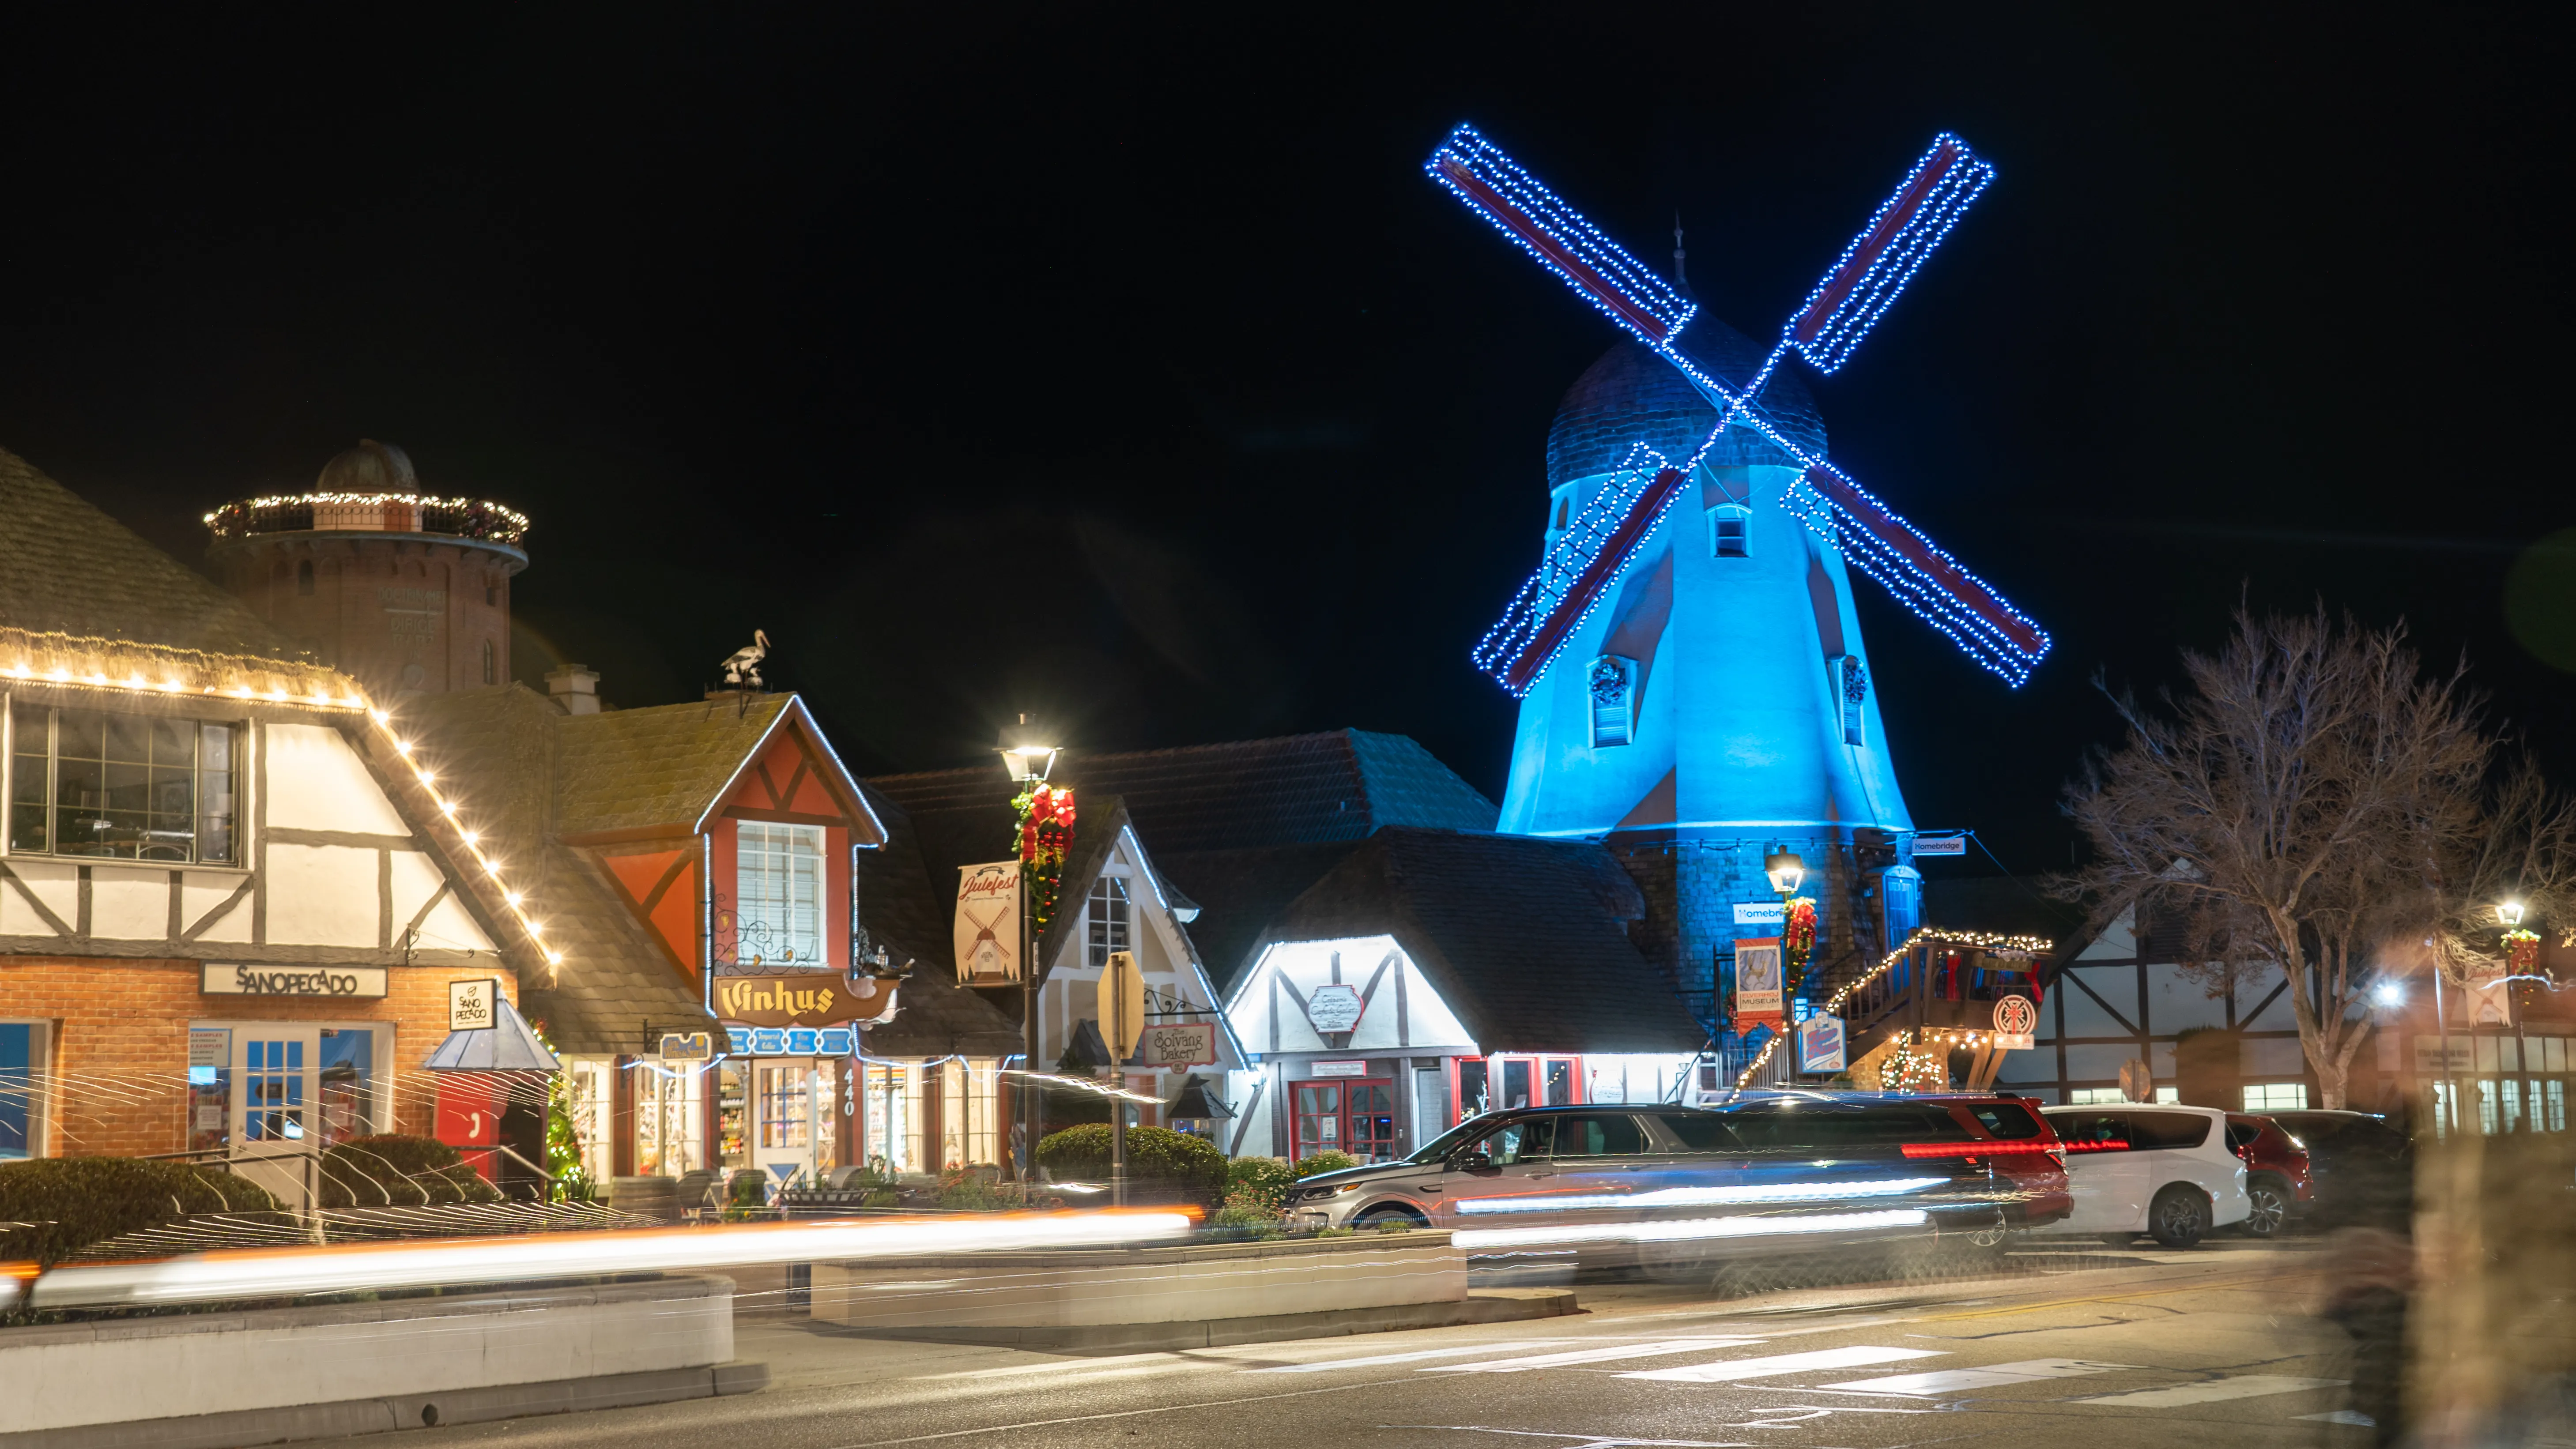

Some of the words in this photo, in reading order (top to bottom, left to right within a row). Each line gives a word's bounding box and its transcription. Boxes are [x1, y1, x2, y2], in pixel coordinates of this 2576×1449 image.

[958, 874, 1019, 900] Julefest
[2467, 967, 2505, 982] Julefest
[459, 996, 480, 1009] SANO
[722, 980, 834, 1018] Vinhus
[456, 1009, 487, 1020] PECADO
[1154, 1031, 1203, 1050] Solvang
[1161, 1047, 1197, 1061] Bakery
[844, 1068, 855, 1116] 440
